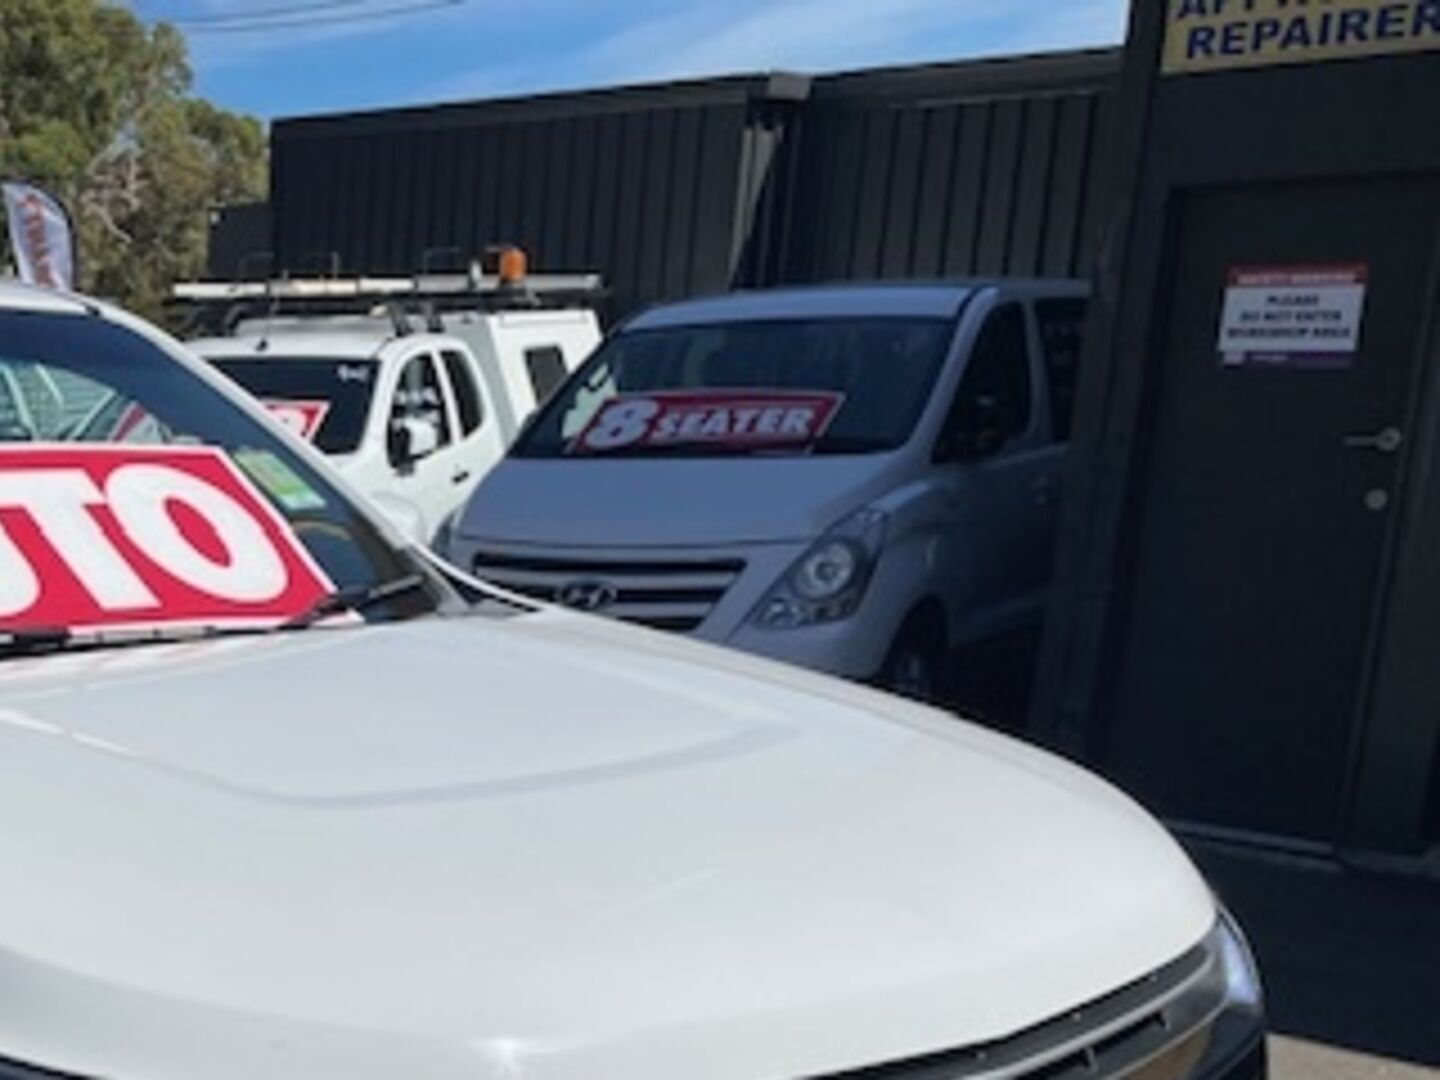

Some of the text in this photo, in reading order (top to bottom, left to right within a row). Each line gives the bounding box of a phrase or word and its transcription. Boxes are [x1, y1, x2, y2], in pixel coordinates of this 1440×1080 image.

[1186, 0, 1440, 59] REPAIRER
[584, 400, 816, 448] 8 SEATER
